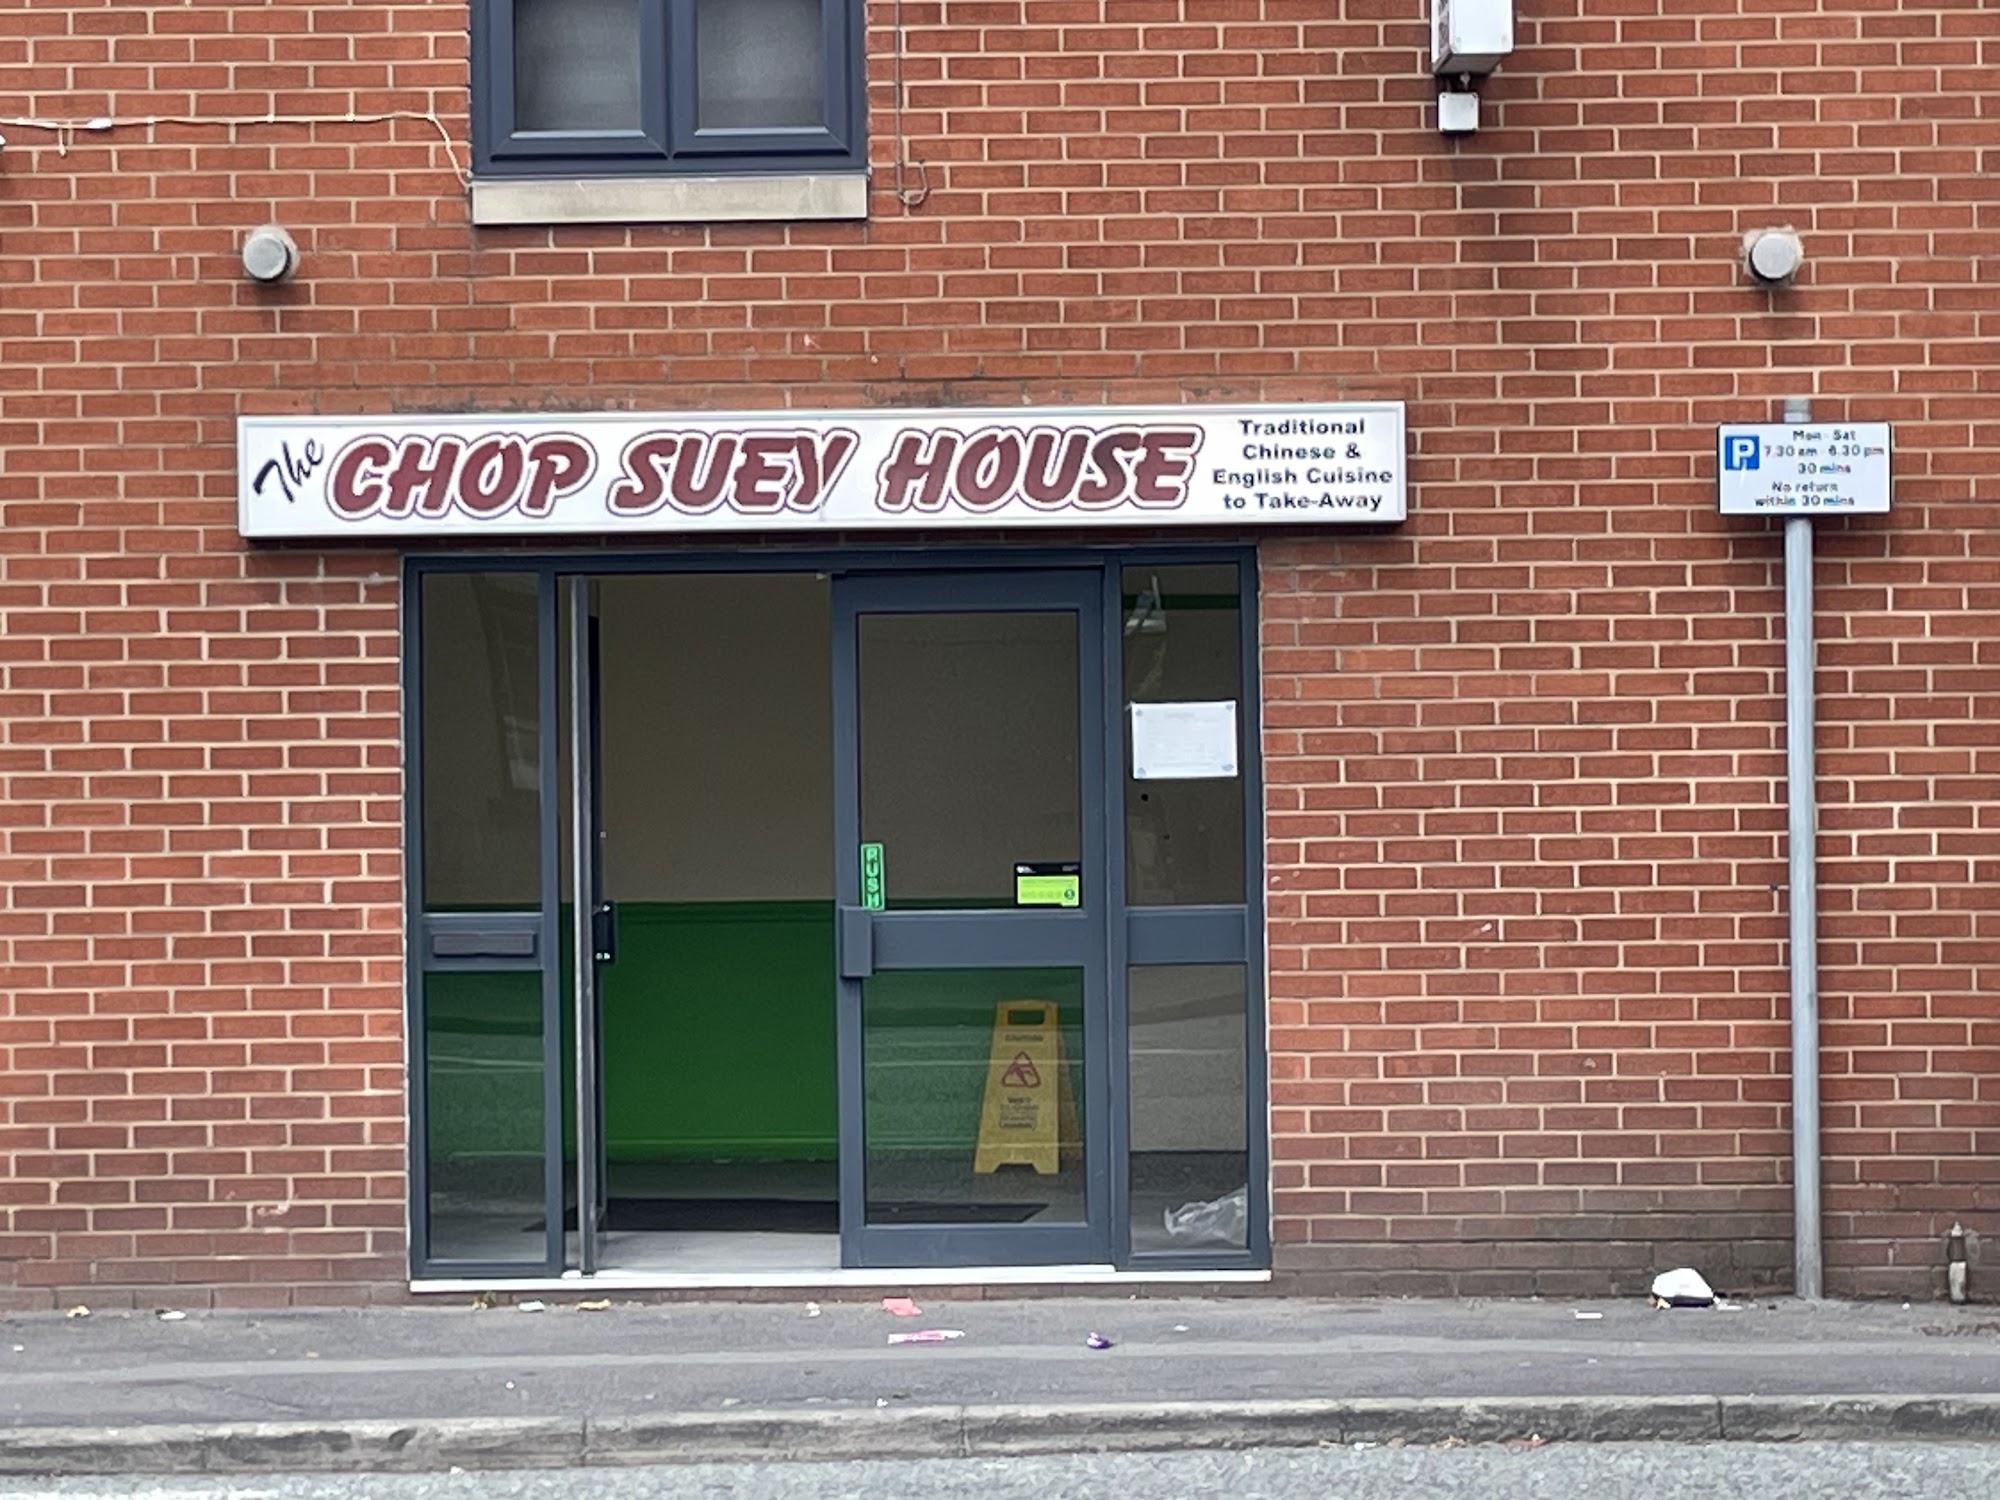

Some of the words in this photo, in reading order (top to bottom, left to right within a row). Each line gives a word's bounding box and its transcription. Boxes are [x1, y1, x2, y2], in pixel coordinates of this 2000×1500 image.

[1239, 418, 1365, 436] Traditional
[1793, 430, 1822, 441] Mon
[1833, 429, 1856, 441] Sat
[1242, 443, 1336, 460] Chinese
[1345, 442, 1362, 459] &
[1731, 438, 1755, 468] P
[1798, 448, 1818, 457] am
[1864, 446, 1885, 459] pm
[253, 437, 324, 504] The
[327, 432, 598, 519] CHOP
[607, 428, 860, 517] SUEY
[877, 424, 1204, 513] HOUSE
[1798, 463, 1817, 474] 30
[1819, 462, 1851, 474] mins
[1212, 467, 1298, 489] English
[1306, 466, 1393, 484] Cuisine
[1772, 481, 1792, 492] No
[1795, 480, 1839, 492] return
[1223, 493, 1246, 509] to
[1254, 491, 1382, 512] Take-Away
[1755, 494, 1796, 507] within
[1802, 494, 1821, 506] 30
[1823, 494, 1855, 506] mins
